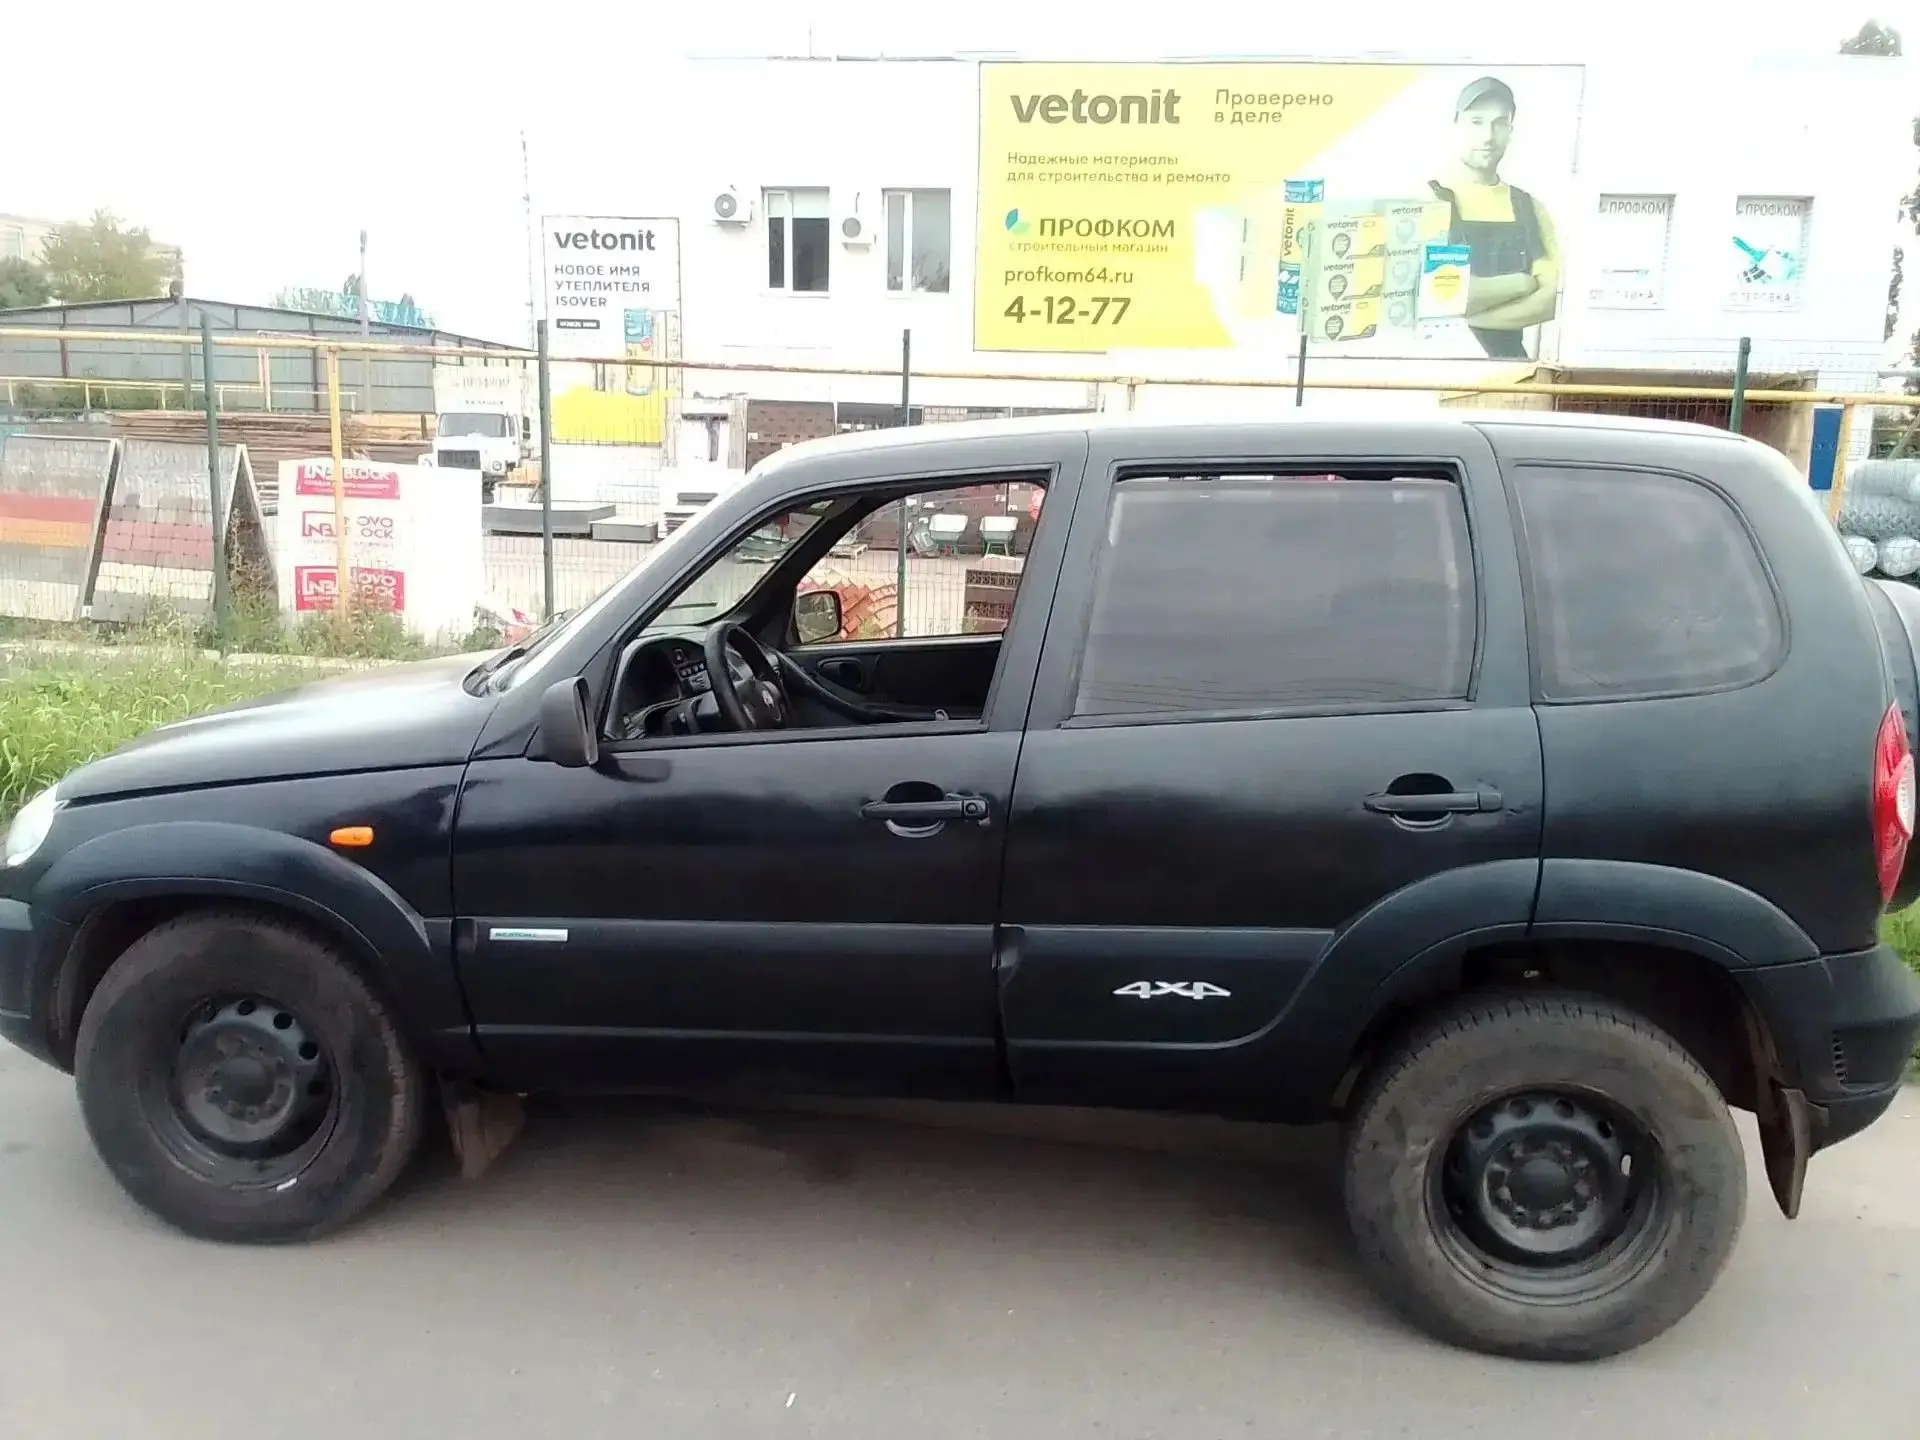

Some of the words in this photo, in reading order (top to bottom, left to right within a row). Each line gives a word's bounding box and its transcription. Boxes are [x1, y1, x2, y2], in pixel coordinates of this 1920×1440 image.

[1010, 89, 1181, 124] vetonit
[1215, 89, 1333, 109] Проверено
[1214, 111, 1224, 123] в
[1230, 110, 1282, 125] деле
[1007, 152, 1088, 166] Надежные
[1093, 154, 1178, 168] материалы
[1007, 171, 1034, 183] для
[1038, 171, 1149, 184] строительства
[1153, 173, 1161, 182] и
[1166, 172, 1231, 185] ремонта
[1609, 201, 1667, 215] ПРОФКОМ
[1745, 203, 1801, 217] ПРОФКОМ
[1039, 218, 1175, 238] ПРОФКОМ
[1283, 208, 1295, 256] vetonit
[554, 229, 655, 251] vetonit
[555, 265, 604, 276] НОВОЕ
[609, 266, 640, 277] ИМЯ
[1004, 266, 1133, 286] profkom64.ru
[555, 280, 650, 292] УТЕПЛИТЕЛЯ
[556, 296, 607, 307] ISOVER
[1004, 295, 1131, 325] 4-12-77
